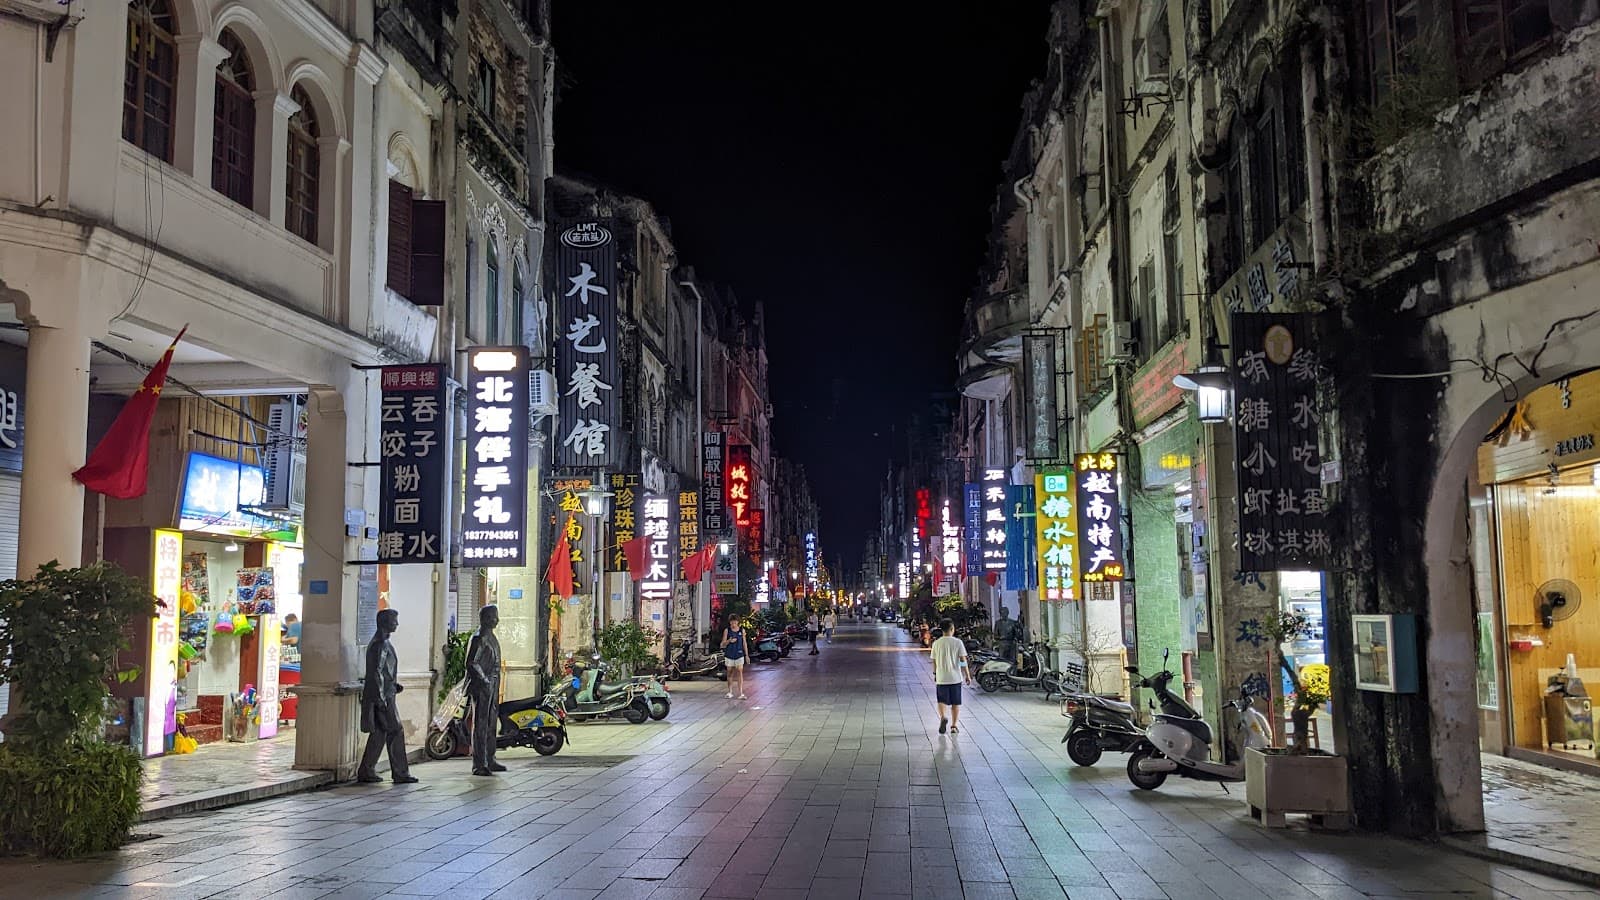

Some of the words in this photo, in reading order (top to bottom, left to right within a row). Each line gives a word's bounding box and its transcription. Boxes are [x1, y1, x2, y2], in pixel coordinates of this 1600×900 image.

[577, 223, 598, 232] LMT
[564, 262, 613, 458] 木艺餐馆
[1238, 348, 1315, 384] 有缘
[383, 371, 436, 387] 順興樓
[381, 396, 438, 423] 云吞
[1238, 395, 1321, 432] 糖水
[380, 430, 437, 457] 饺子
[473, 376, 514, 524] 北海伴手礼
[1079, 454, 1115, 471] 北海
[1242, 440, 1320, 477] 小吃
[394, 464, 421, 492] 粉
[611, 474, 639, 488] 精工
[394, 498, 421, 524] 面
[1244, 487, 1326, 515] 虾扯蛋
[1082, 471, 1116, 573] 越南特产
[377, 531, 438, 559] 糖水
[1244, 528, 1332, 556] 冰淇淋
[157, 537, 177, 646] 特产超市
